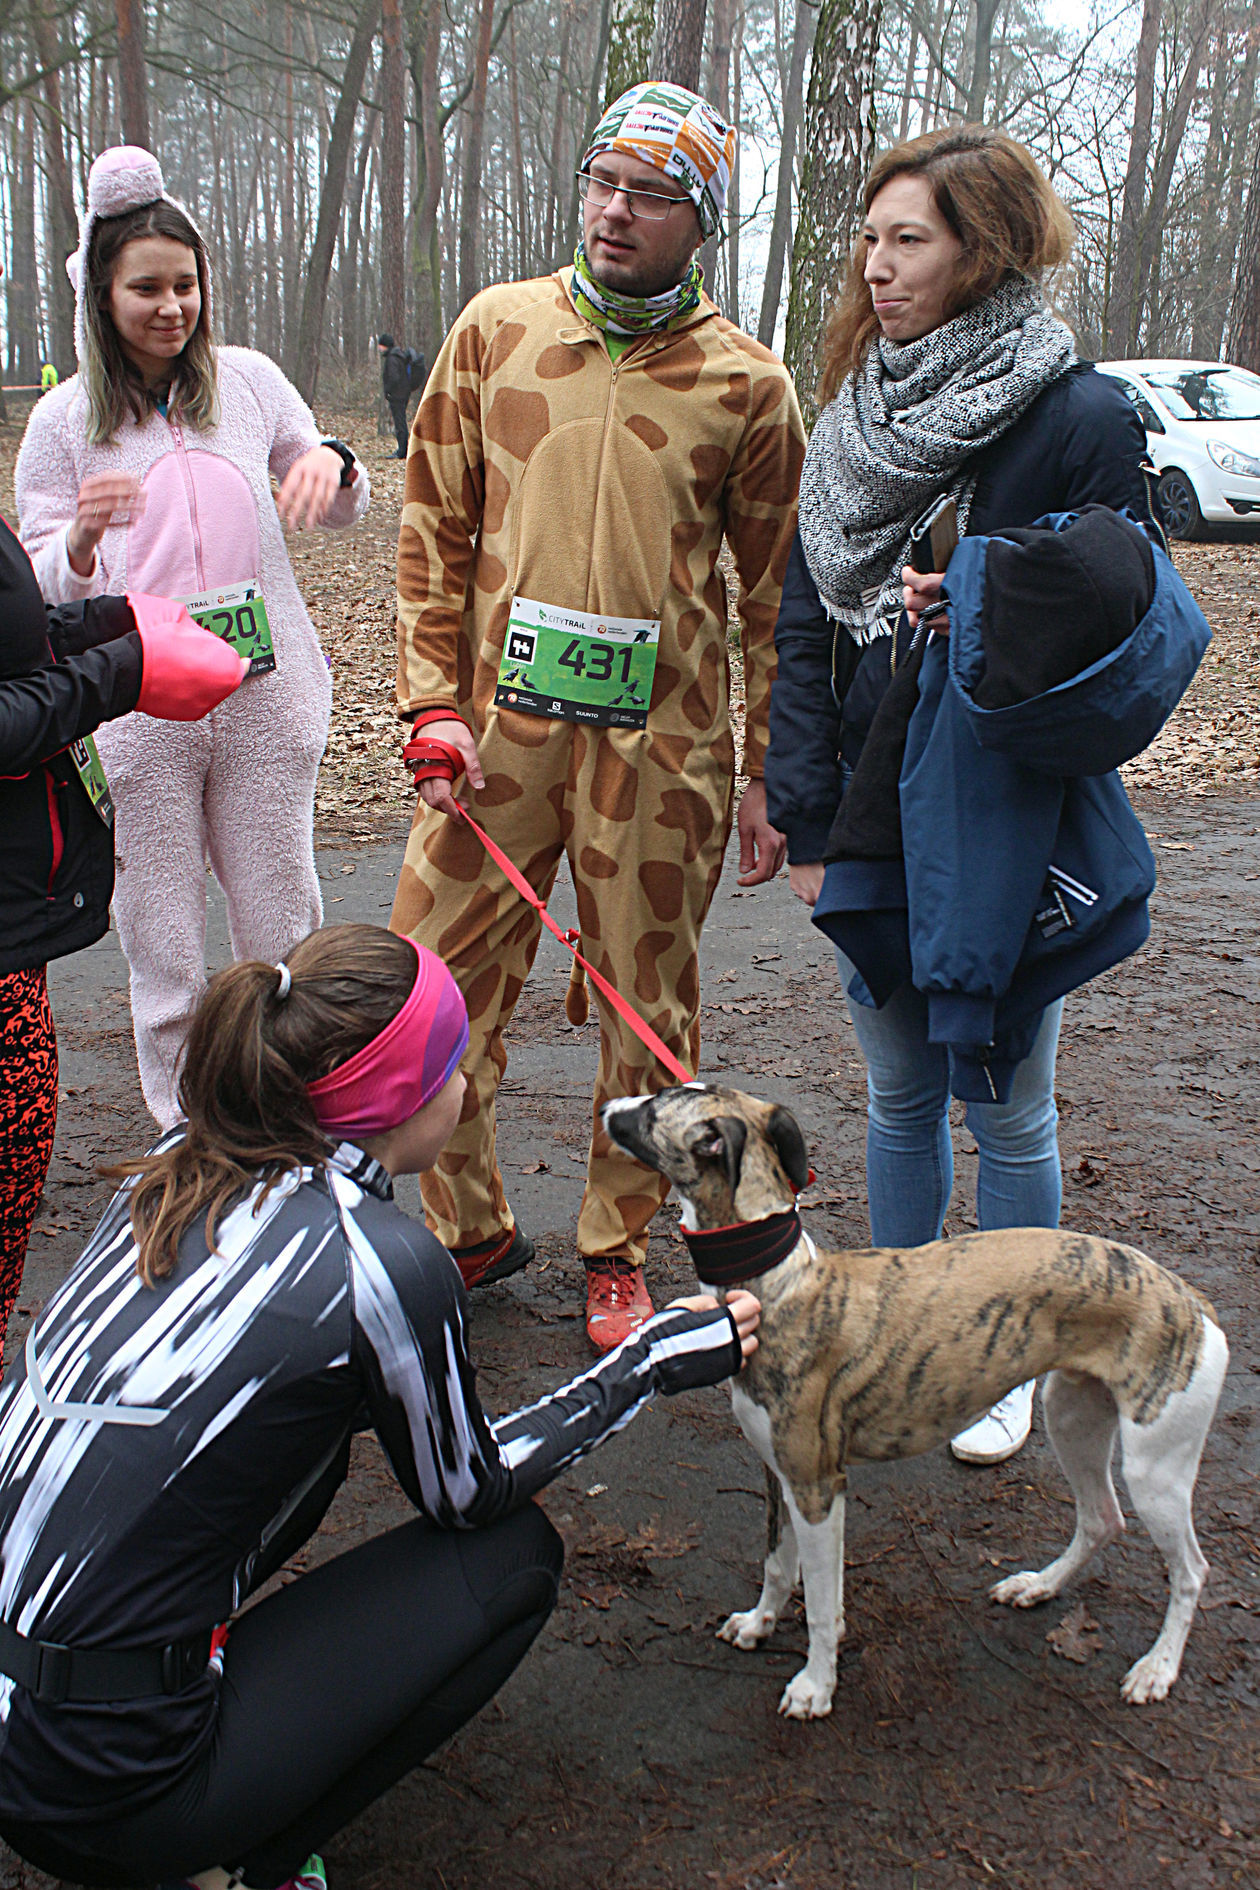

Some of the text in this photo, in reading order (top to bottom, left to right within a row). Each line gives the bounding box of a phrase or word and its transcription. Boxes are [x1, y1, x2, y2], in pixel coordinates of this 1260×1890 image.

[196, 606, 257, 643] 20
[558, 639, 633, 683] 431
[576, 710, 599, 719] SUUNTO
